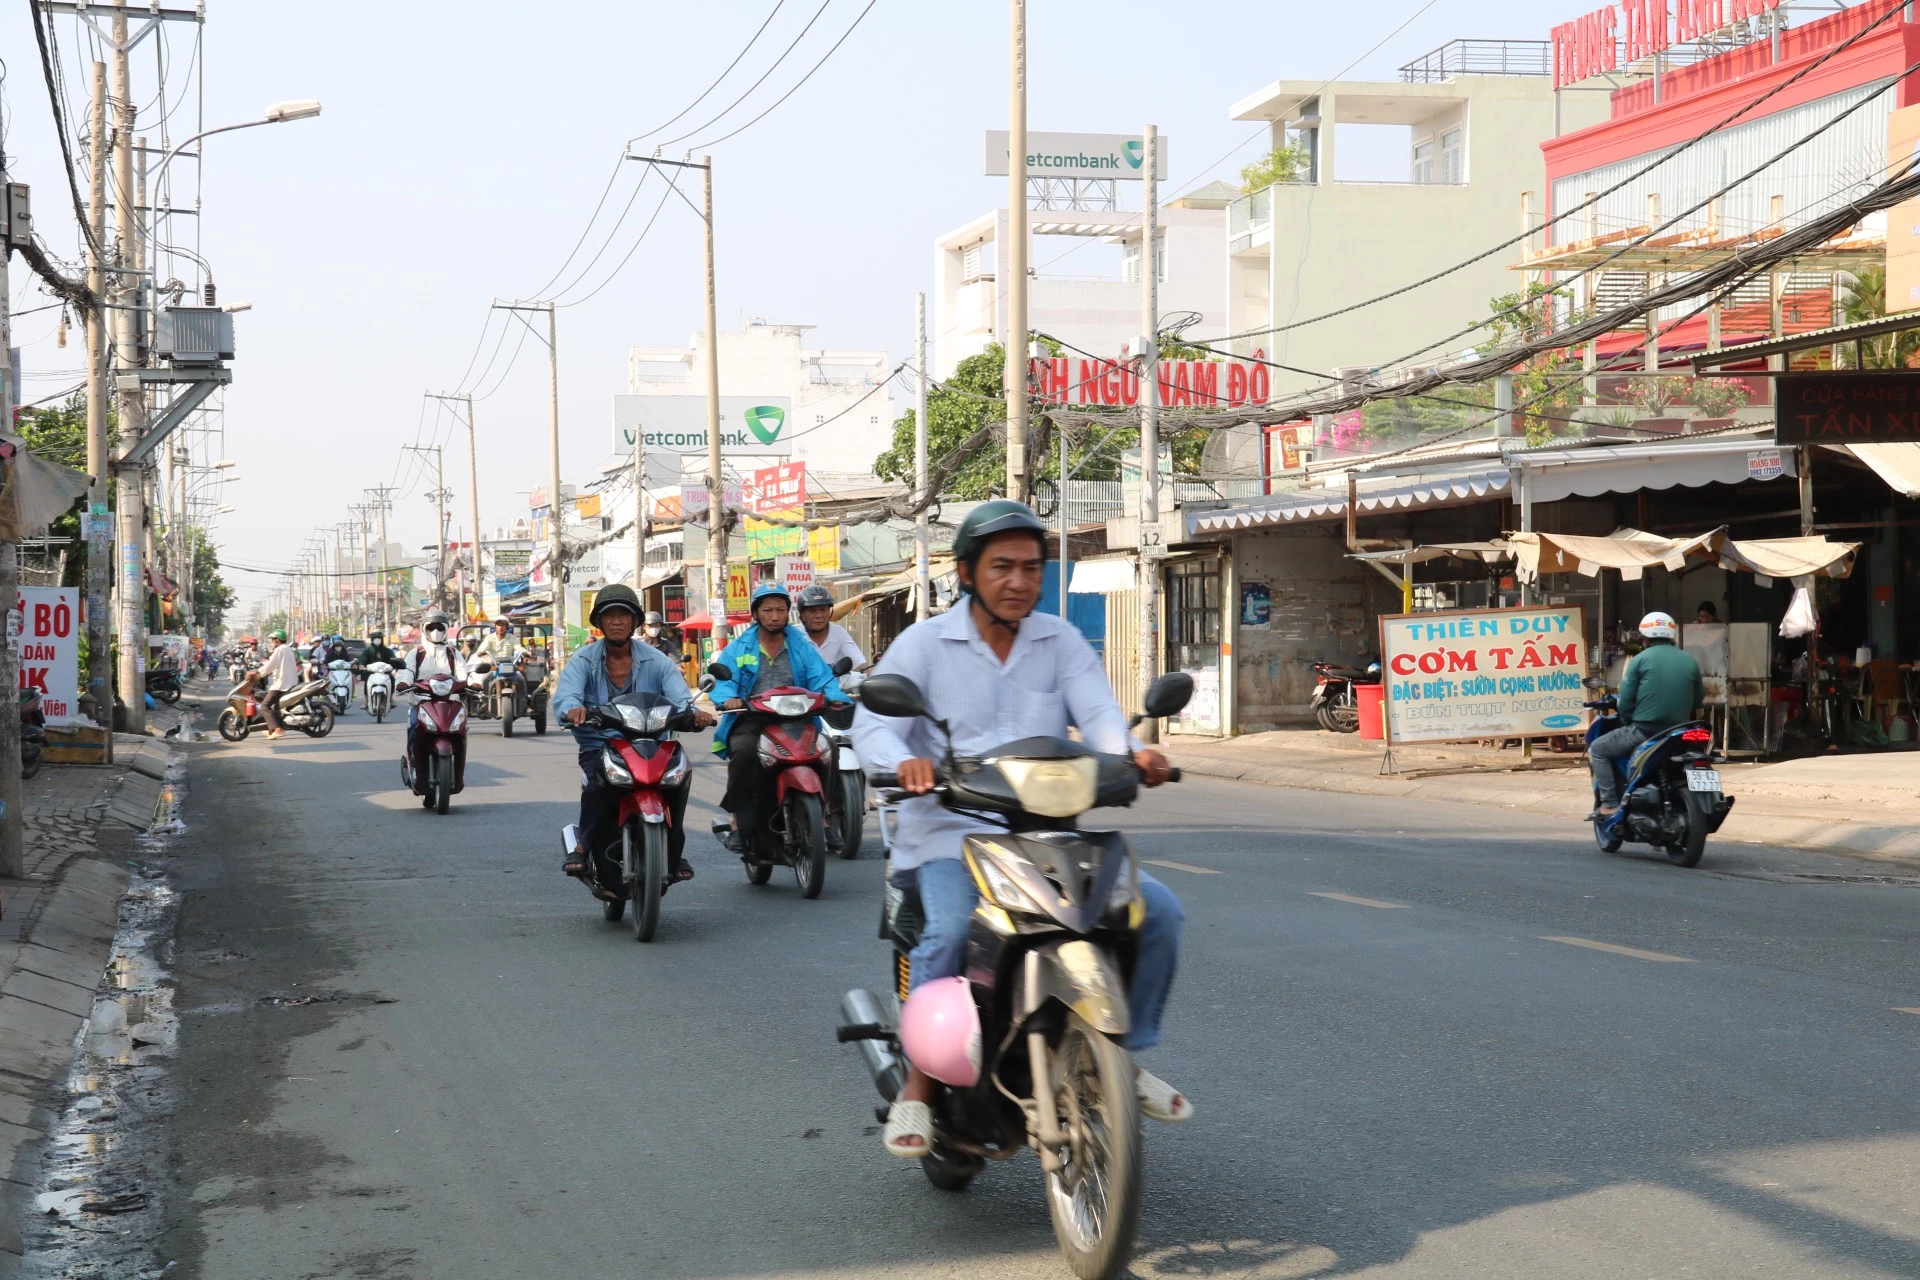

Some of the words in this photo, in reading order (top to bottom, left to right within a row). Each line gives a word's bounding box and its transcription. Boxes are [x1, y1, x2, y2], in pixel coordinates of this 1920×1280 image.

[1551, 5, 1617, 89] TRUNG
[1007, 151, 1120, 169] etcombank
[1158, 361, 1217, 407] NAM
[1227, 347, 1270, 408] ĐÔ
[1796, 405, 1873, 435] TẤN
[623, 429, 748, 446] Vetcomank
[686, 491, 710, 502] TRUN
[35, 596, 70, 638] BÒ
[1406, 617, 1499, 641] THIÊN
[1509, 615, 1570, 635] DUY
[24, 642, 55, 661] DÂN
[1391, 647, 1478, 676] CƠM
[1489, 634, 1579, 670] TẤM
[1393, 681, 1420, 704] ĐẶC
[1424, 677, 1459, 701] BIỆT:
[1461, 674, 1497, 696] SƯỜN
[1500, 675, 1535, 697] CỌNG
[1538, 670, 1581, 692] NƯỚNG
[1457, 702, 1506, 717] THỊT
